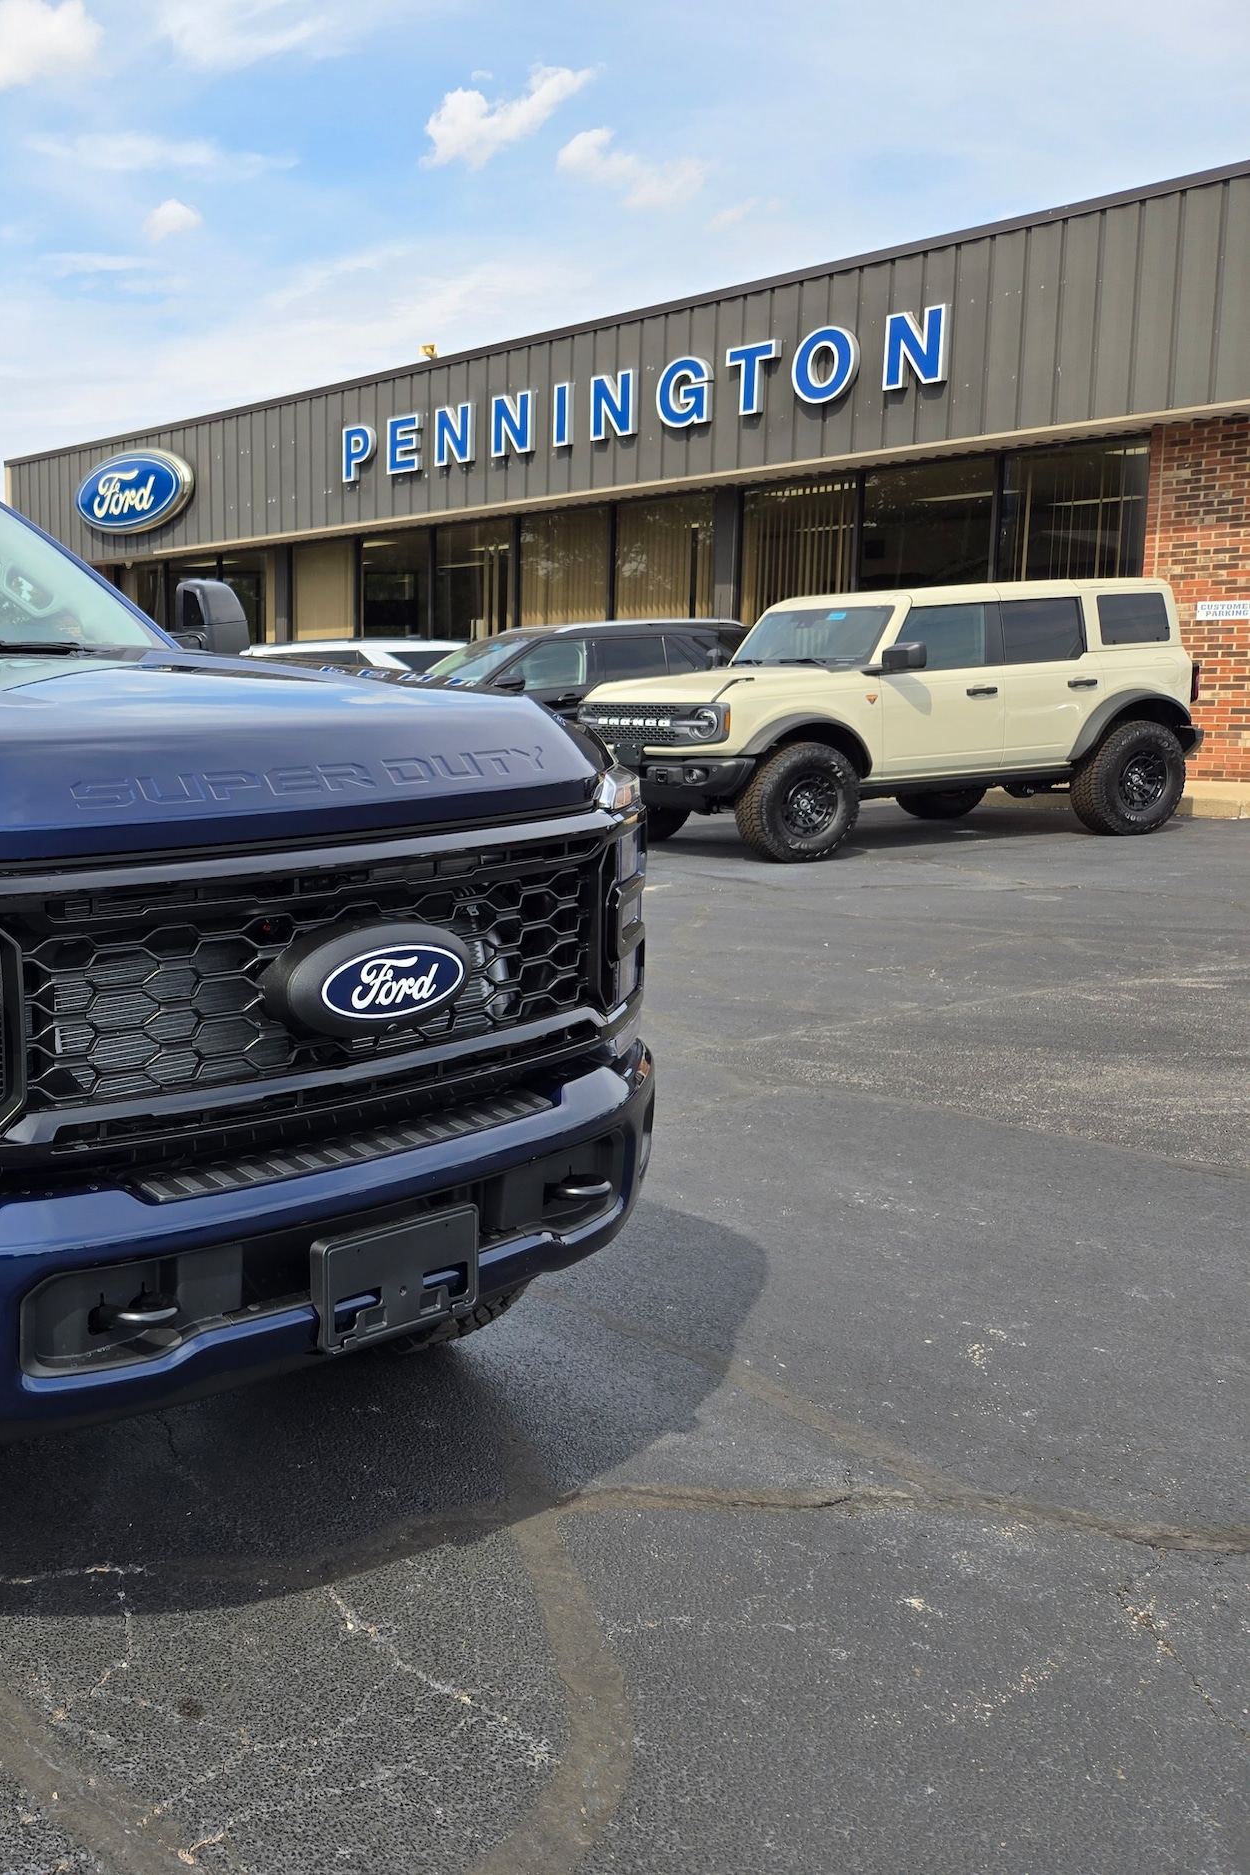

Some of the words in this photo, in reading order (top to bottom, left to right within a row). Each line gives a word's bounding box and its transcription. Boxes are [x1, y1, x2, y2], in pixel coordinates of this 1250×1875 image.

[342, 303, 951, 483] PENNINGTON
[92, 467, 156, 519] Ford
[1200, 603, 1250, 611] CUSTOME
[1205, 609, 1249, 617] PARKING
[597, 717, 670, 727] BRONCO
[69, 761, 377, 810] SUPER
[380, 745, 544, 787] DUTY
[351, 955, 440, 1010] Ford
